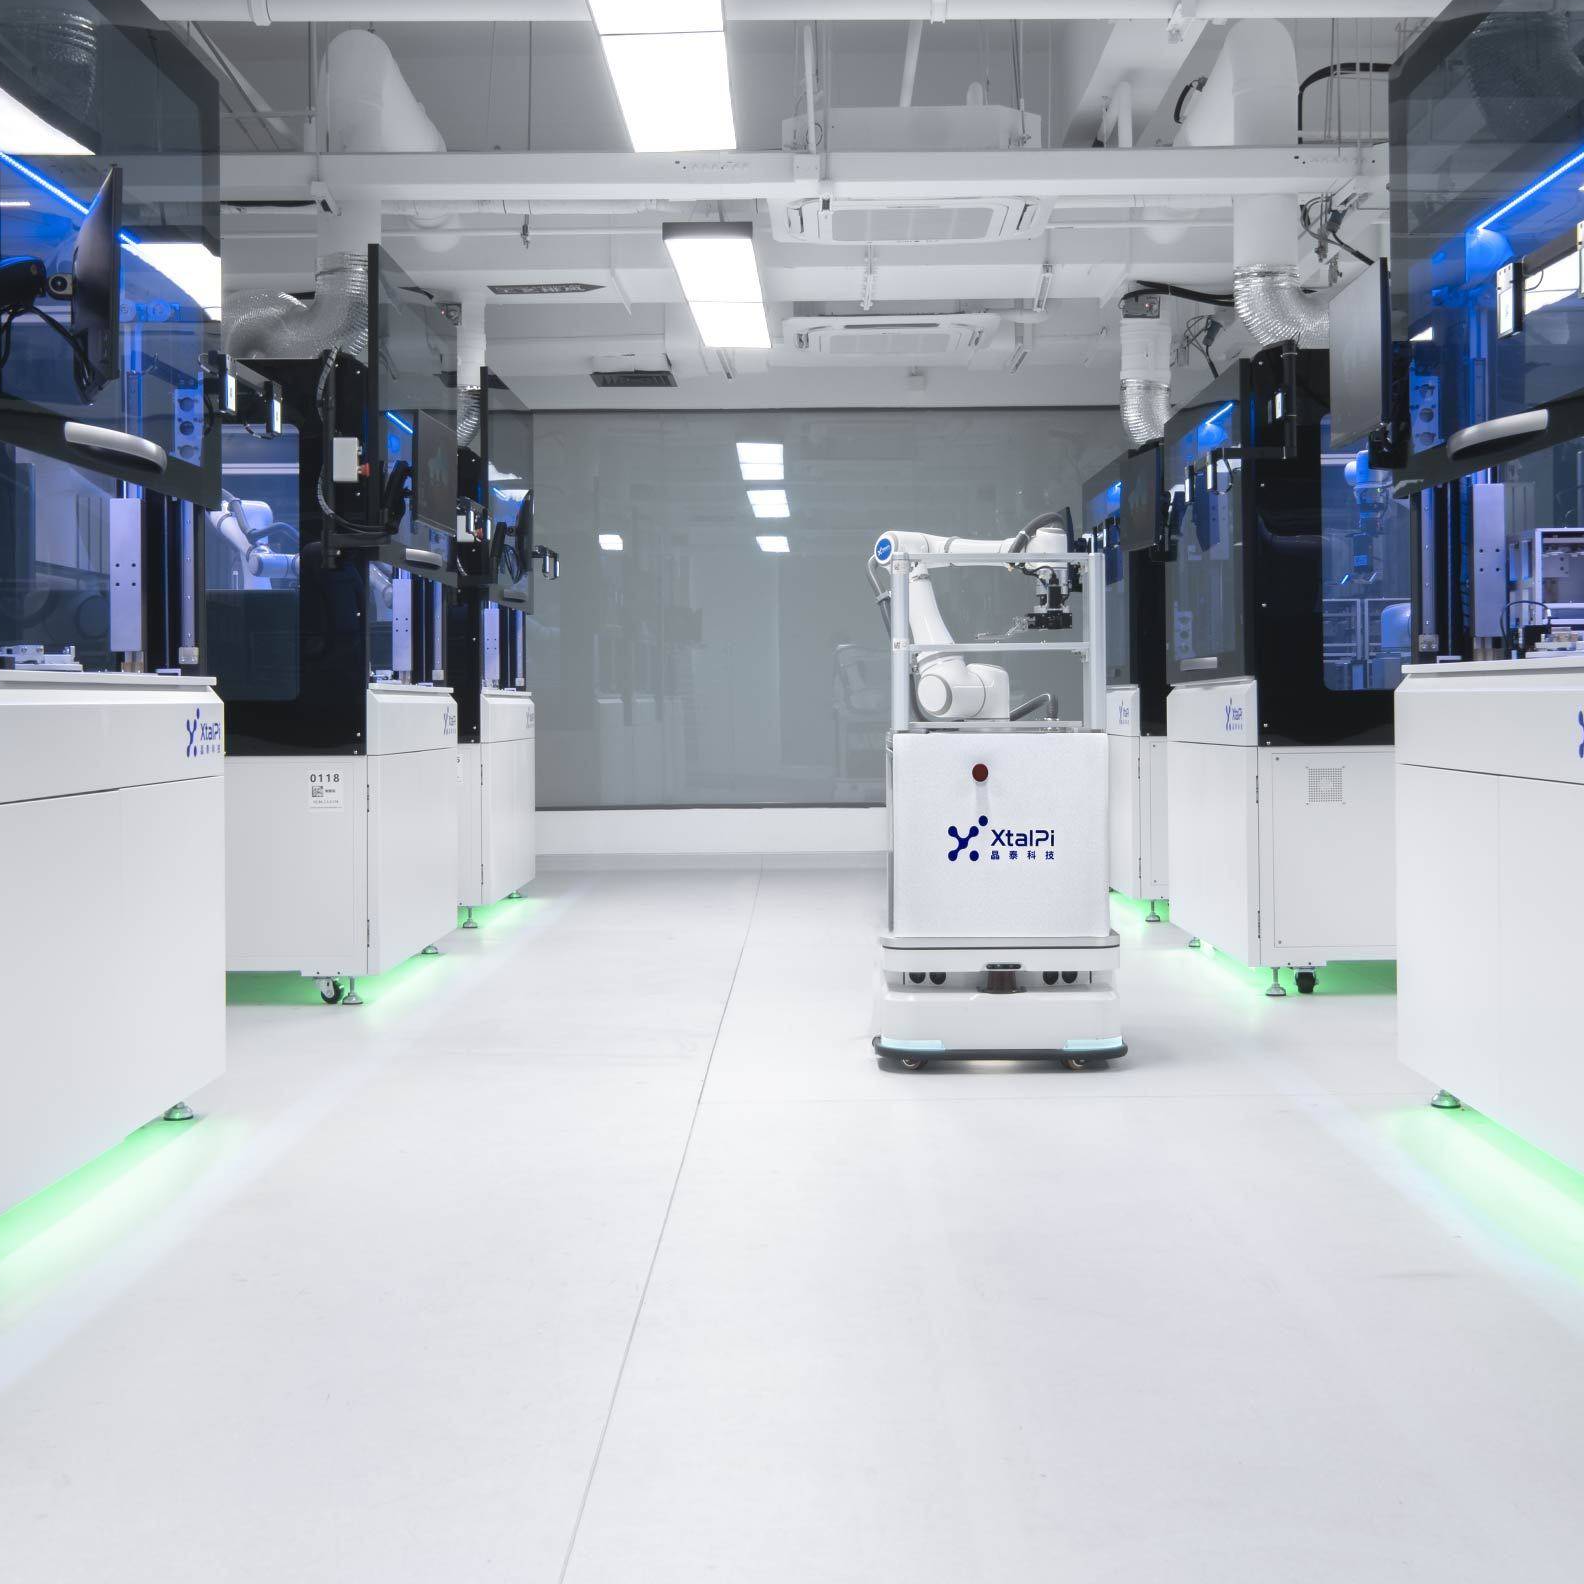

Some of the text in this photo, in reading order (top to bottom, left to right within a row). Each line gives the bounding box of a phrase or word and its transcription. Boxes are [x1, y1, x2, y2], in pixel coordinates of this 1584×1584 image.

[310, 773, 340, 783] 0118
[990, 829, 1055, 847] XtalPi
[990, 850, 1055, 860] 晶泰科技
